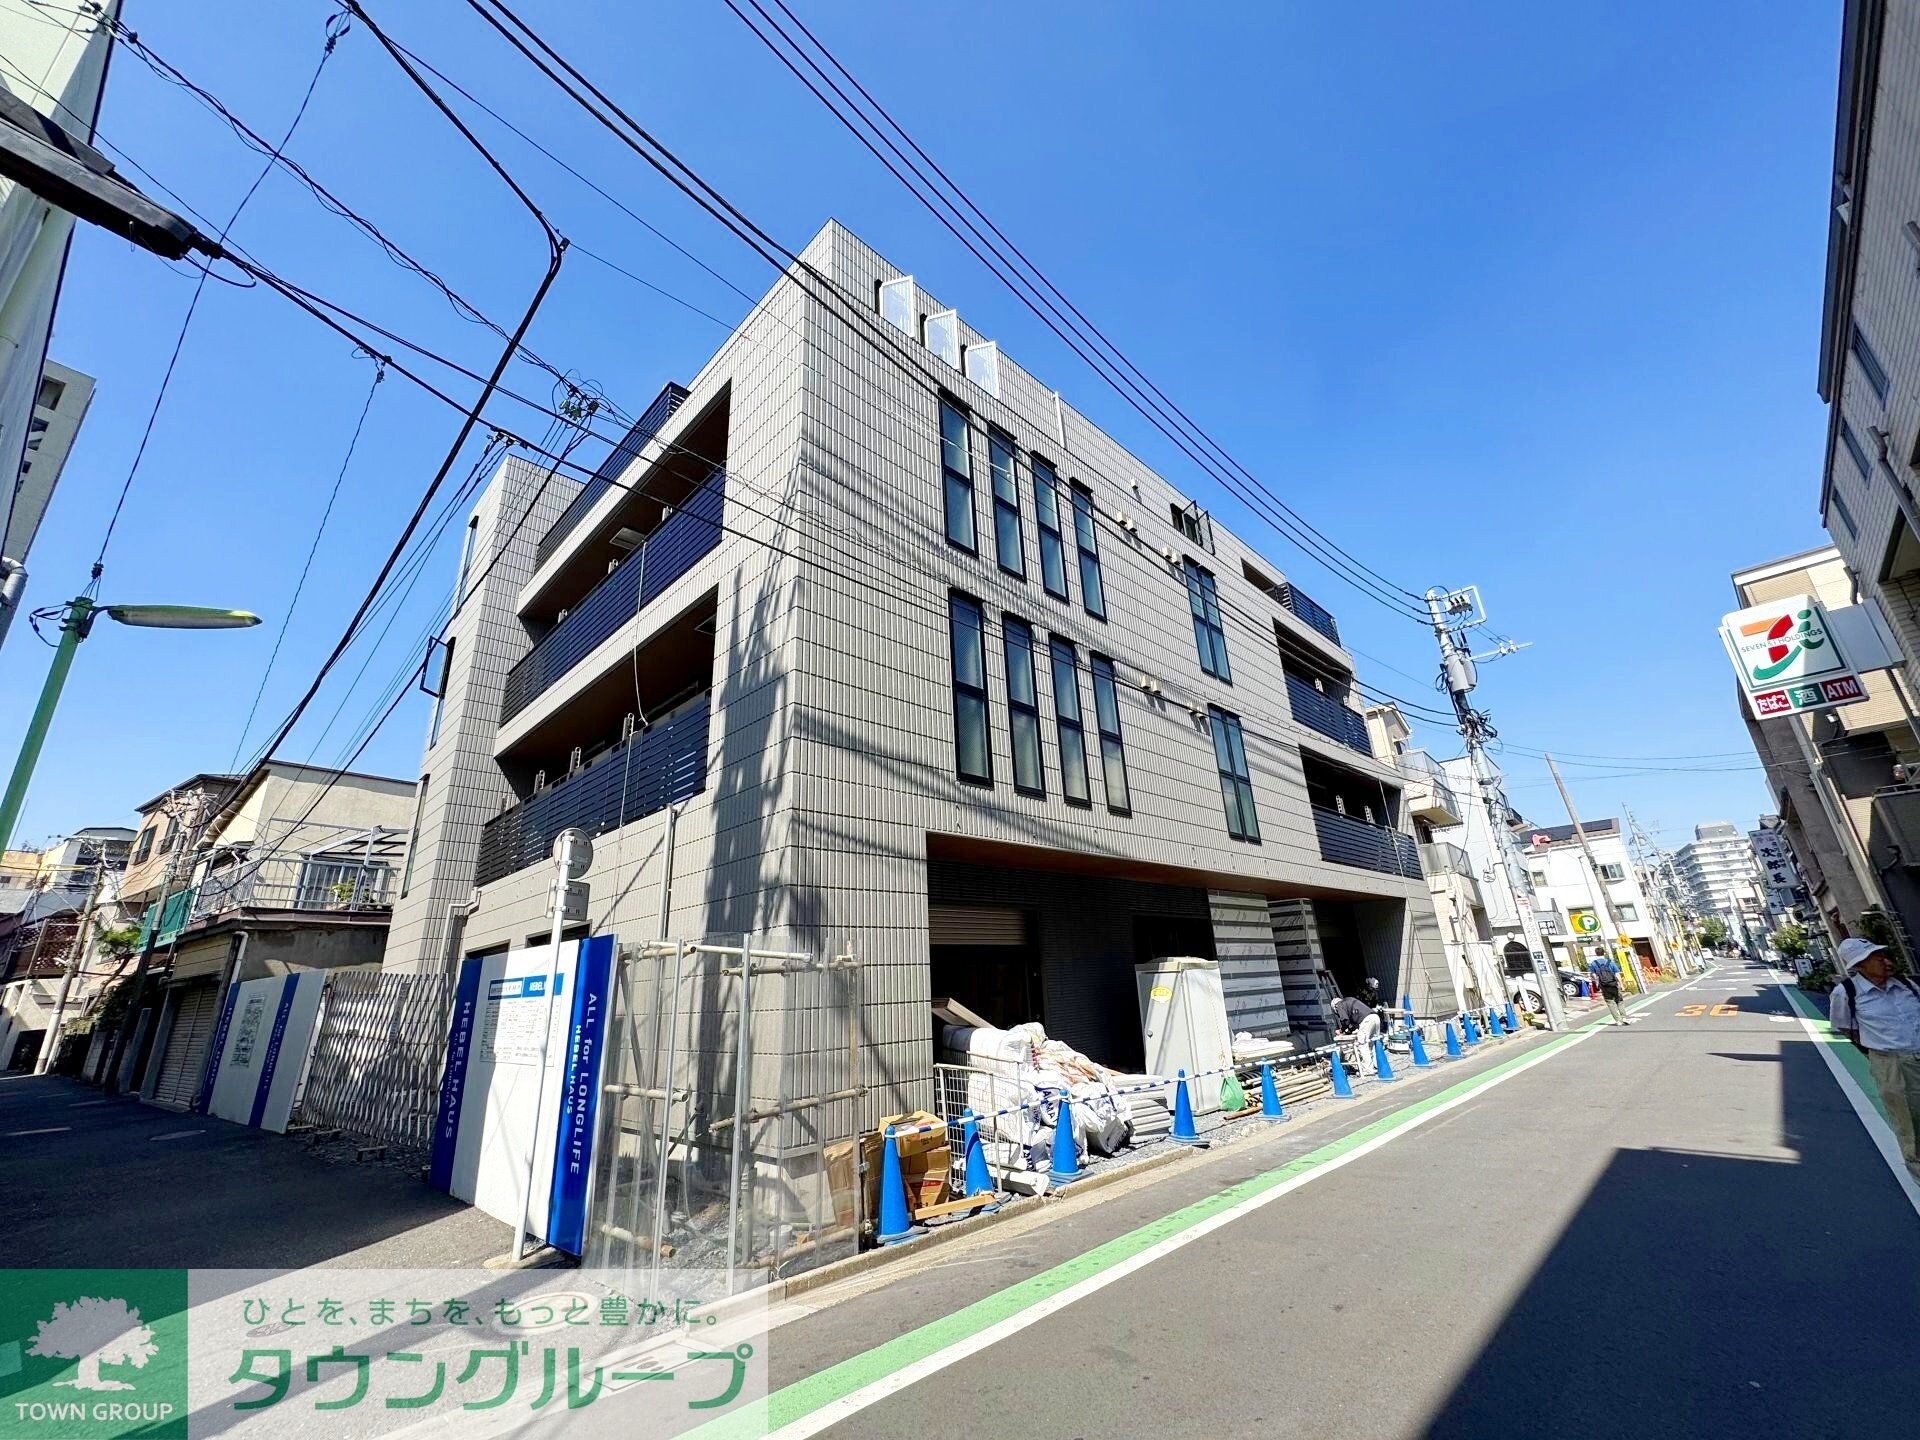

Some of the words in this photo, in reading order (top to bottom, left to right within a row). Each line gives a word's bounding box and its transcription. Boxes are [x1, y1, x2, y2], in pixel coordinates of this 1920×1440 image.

[1778, 628, 1823, 645] HOLDINGS
[1757, 694, 1790, 712] たばこ
[1794, 688, 1818, 705] 酒
[1828, 680, 1859, 699] ATM
[1760, 847, 1787, 883] 次郎長
[585, 993, 598, 1028] ALL
[455, 1002, 471, 1071] HEBEL
[571, 1025, 582, 1072] HEBEL
[583, 1037, 593, 1064] for
[445, 1078, 460, 1138] HAUS
[567, 1075, 576, 1114] HAUS
[571, 1072, 589, 1175] LONGLIFE
